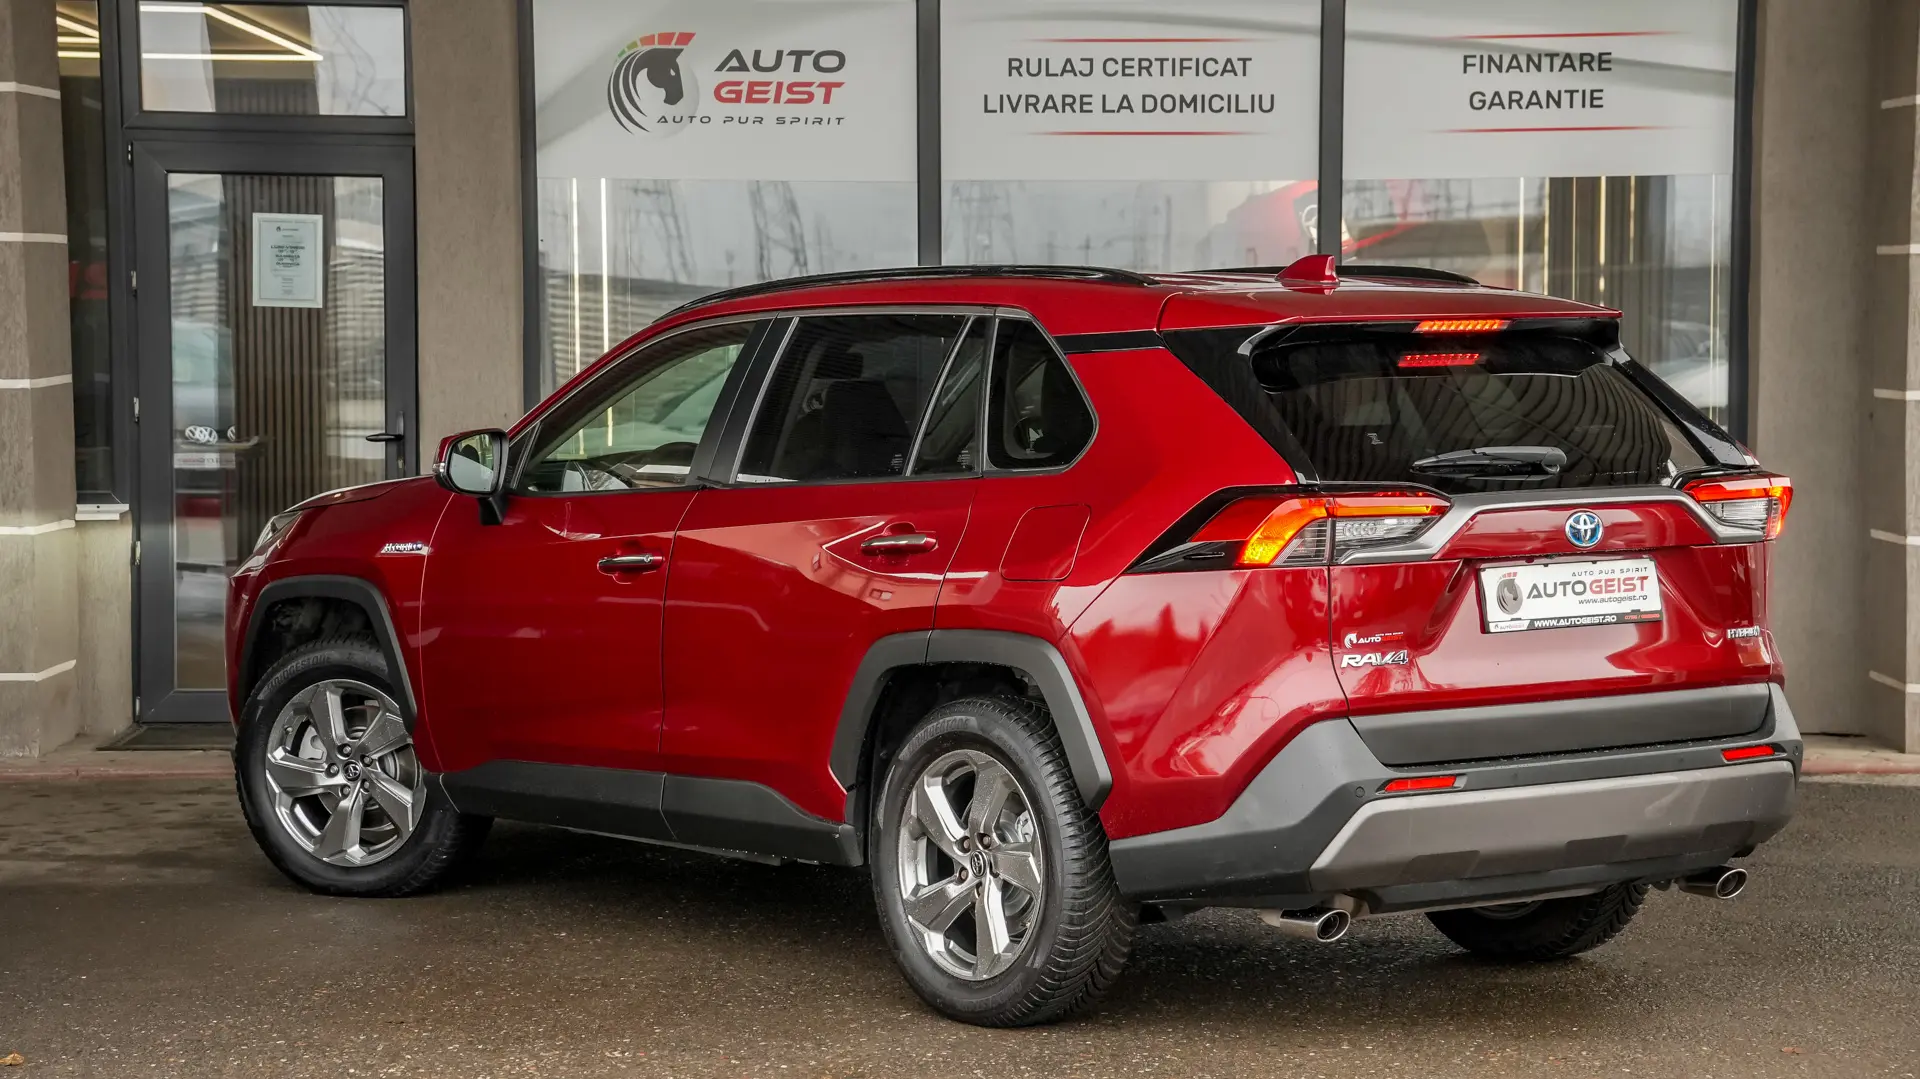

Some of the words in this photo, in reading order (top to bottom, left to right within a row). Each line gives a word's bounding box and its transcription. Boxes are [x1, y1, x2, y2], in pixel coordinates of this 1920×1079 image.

[713, 48, 846, 73] AUTO
[1007, 57, 1094, 77] RULAJ
[1102, 57, 1253, 77] CERTIFICAT
[1463, 52, 1612, 74] FINANTARE
[713, 80, 846, 105] GEIST
[1469, 88, 1604, 111] GARANTIE
[983, 94, 1093, 114] LIVRARE
[1101, 94, 1135, 114] LA
[1141, 94, 1276, 114] DOMICILIU
[656, 115, 711, 125] AUTO
[723, 116, 764, 125] PUR
[775, 116, 845, 126] SPIRIT
[1526, 575, 1649, 599] AUTOGEIST
[1578, 594, 1648, 604] www.autogeist.ro
[1534, 615, 1617, 628] WWW.AUTOGEIST.RO
[1340, 649, 1408, 668] RAV4
